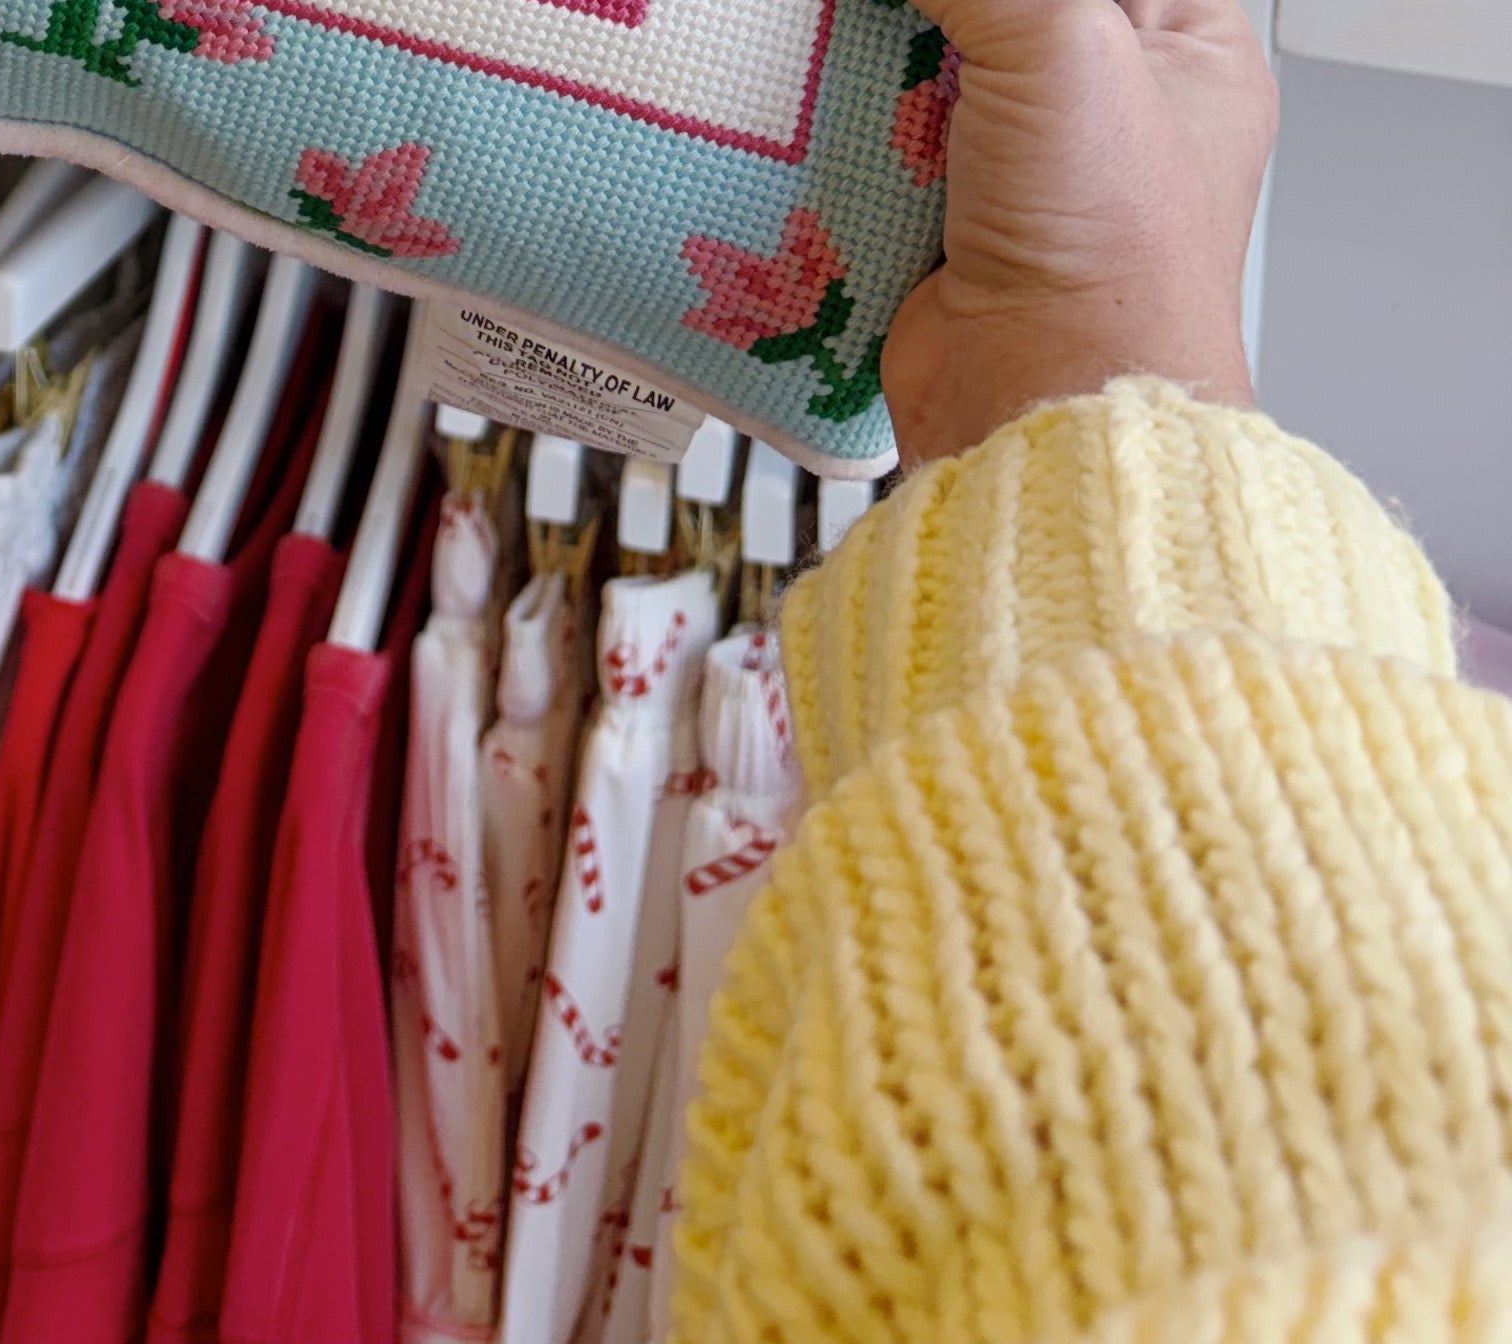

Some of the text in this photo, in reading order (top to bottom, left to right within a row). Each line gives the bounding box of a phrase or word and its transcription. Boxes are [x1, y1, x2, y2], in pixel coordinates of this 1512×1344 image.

[460, 309, 519, 345] UNDER
[521, 337, 603, 384] PENALTY
[604, 374, 632, 395] OF
[631, 384, 676, 412] LAW
[475, 330, 514, 353] THIS
[555, 367, 593, 388] NOT
